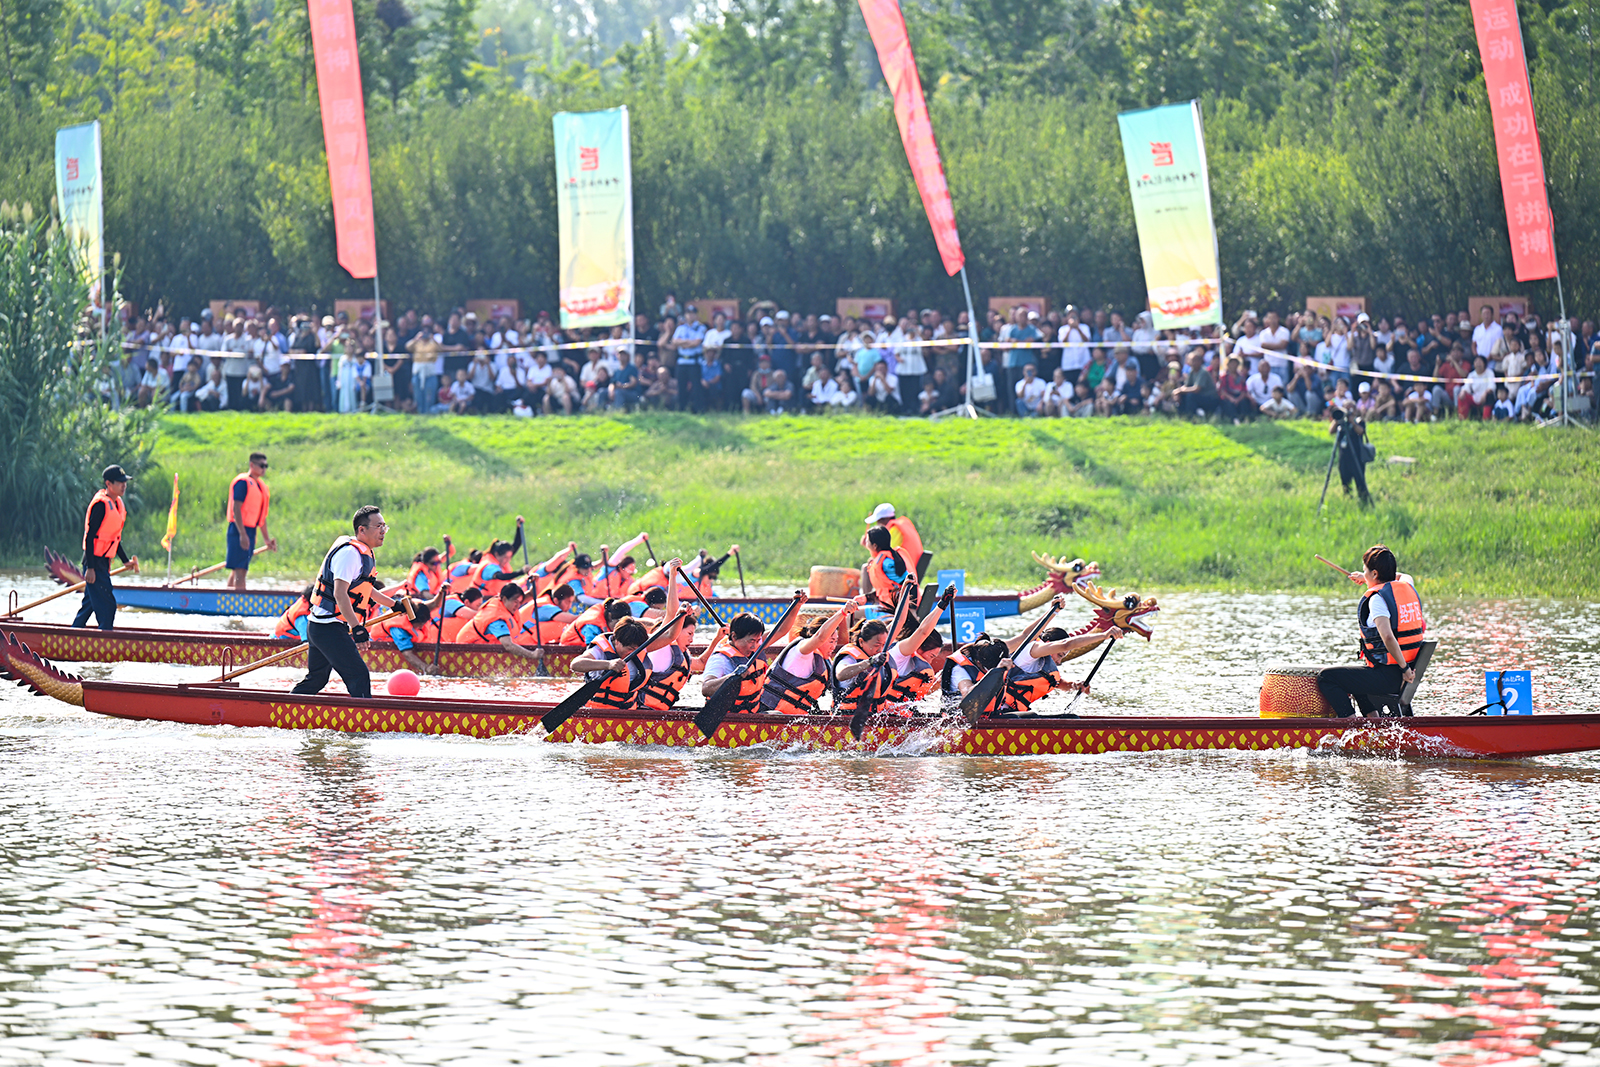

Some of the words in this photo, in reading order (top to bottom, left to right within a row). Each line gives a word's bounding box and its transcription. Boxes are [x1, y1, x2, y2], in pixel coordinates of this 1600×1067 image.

[320, 0, 349, 72] 精神
[1482, 0, 1513, 61] 运动
[1499, 80, 1550, 257] 成功在于拼搏
[332, 99, 368, 255] 展青春风采
[961, 621, 976, 642] 3
[1399, 602, 1422, 624] 经开区
[1501, 687, 1519, 714] 2
